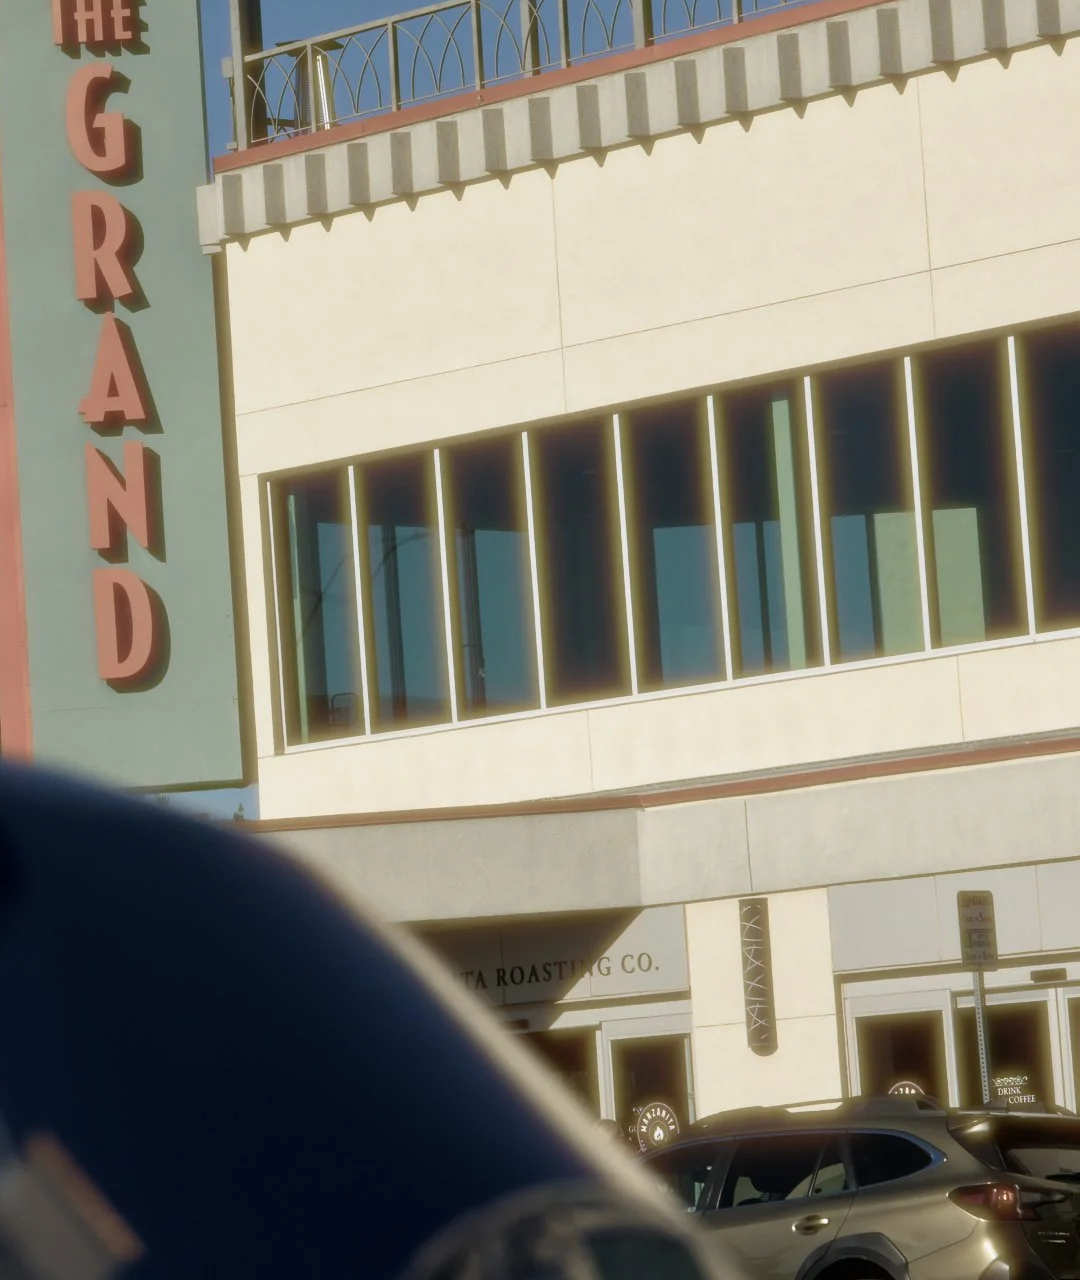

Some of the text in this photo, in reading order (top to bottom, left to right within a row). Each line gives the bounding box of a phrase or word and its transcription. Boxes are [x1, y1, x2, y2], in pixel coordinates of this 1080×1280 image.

[65, 62, 166, 686] GRAND
[496, 956, 611, 986] ROASTING
[621, 952, 659, 974] CO.
[997, 1087, 1022, 1096] DRINK
[1008, 1095, 1036, 1104] COFFEE
[640, 1107, 676, 1133] MANZANITA
